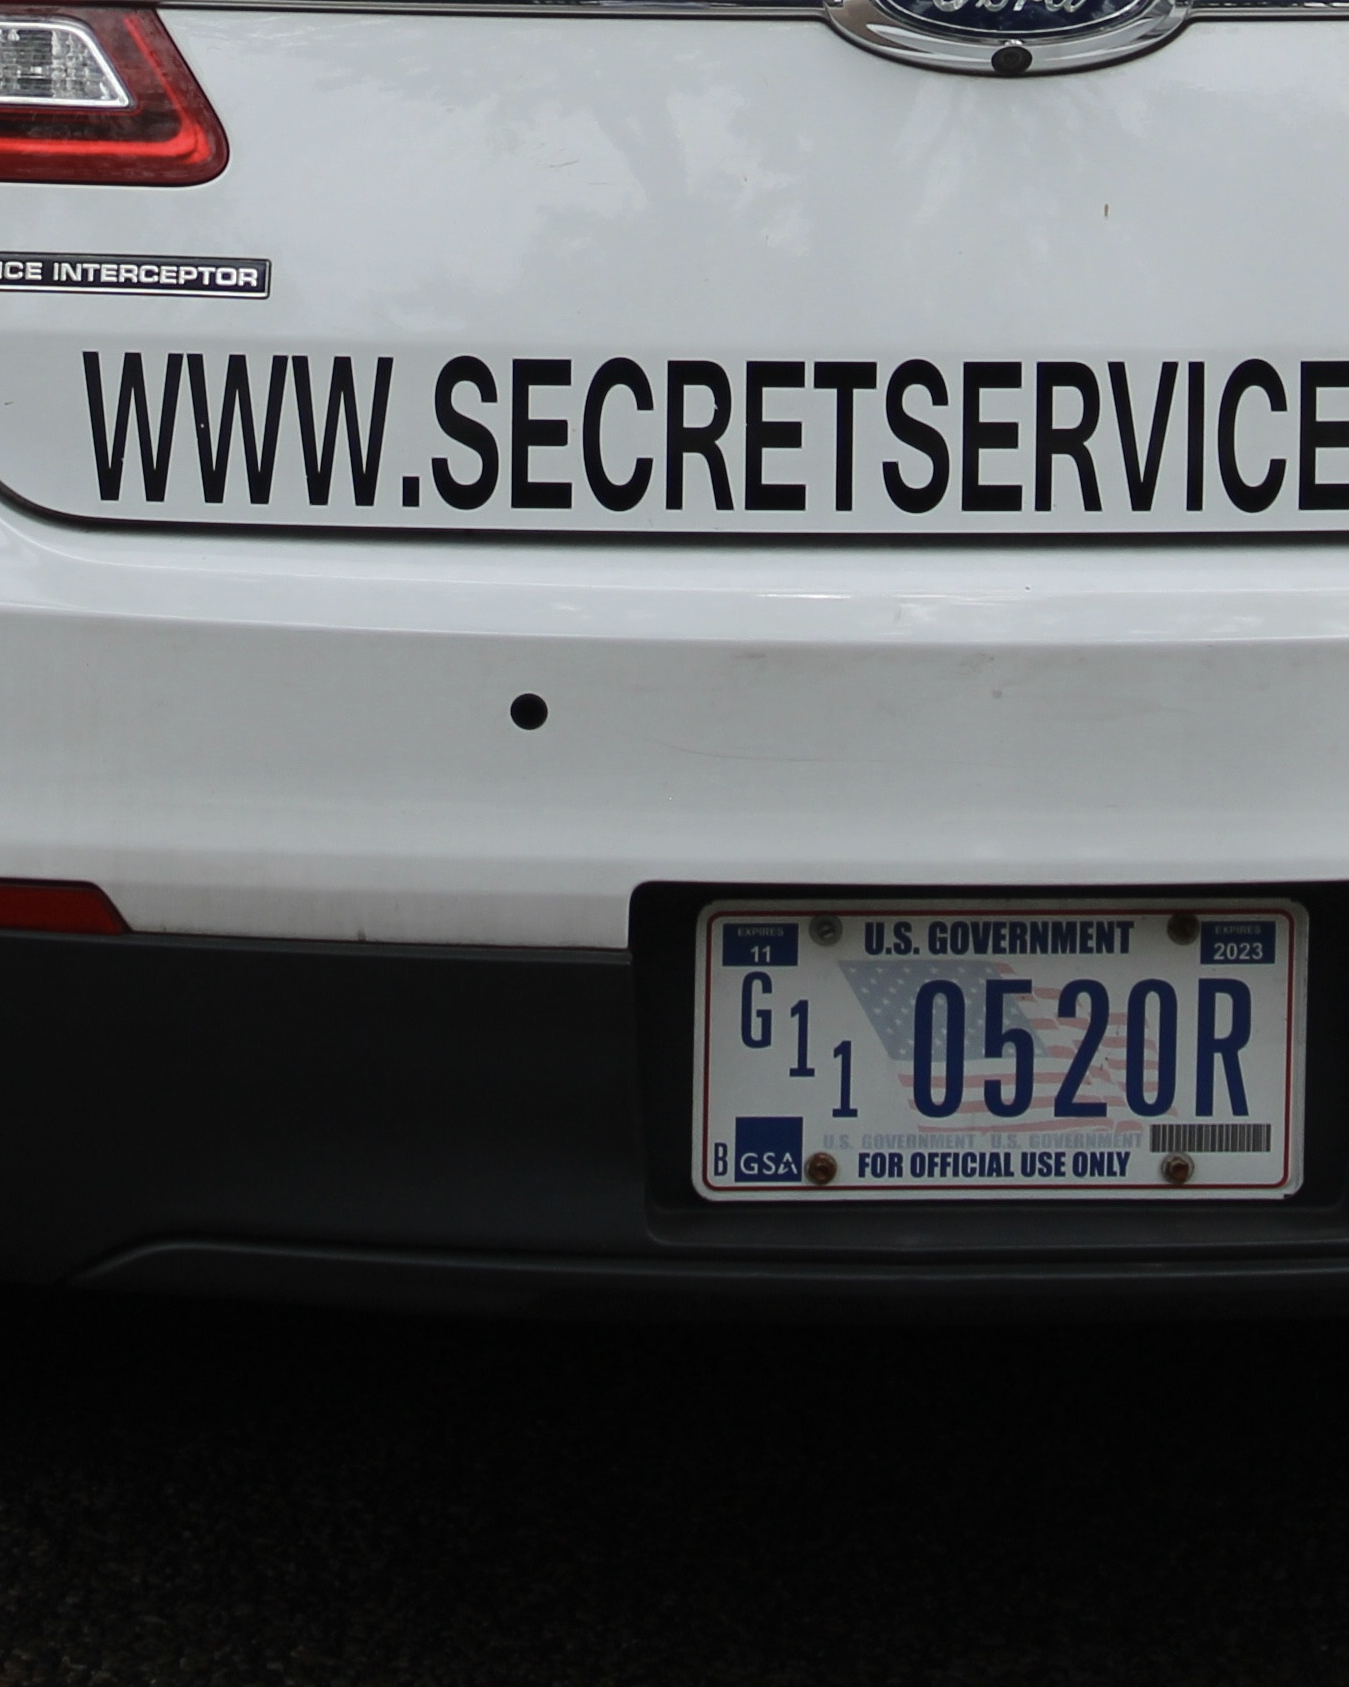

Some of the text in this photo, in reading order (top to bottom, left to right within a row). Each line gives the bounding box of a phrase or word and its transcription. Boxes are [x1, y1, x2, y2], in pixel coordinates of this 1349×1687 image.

[52, 261, 259, 288] INTERCEPTOR
[737, 927, 785, 937] EXPIRES
[864, 920, 1135, 956] U.S. GOVERNMENT
[1214, 925, 1262, 935] EXPIRES
[750, 945, 772, 963] 11
[1212, 942, 1264, 961] 2023
[912, 978, 1252, 1118] 0520R
[823, 1134, 853, 1150] U.S.
[861, 1133, 976, 1150] GOVERNMENT
[1028, 1132, 1143, 1150] GOVERNMENT
[713, 1142, 729, 1177] B
[739, 1151, 799, 1176] GSA
[857, 1150, 1132, 1179] FOR OFFICIAL USE ONLY
